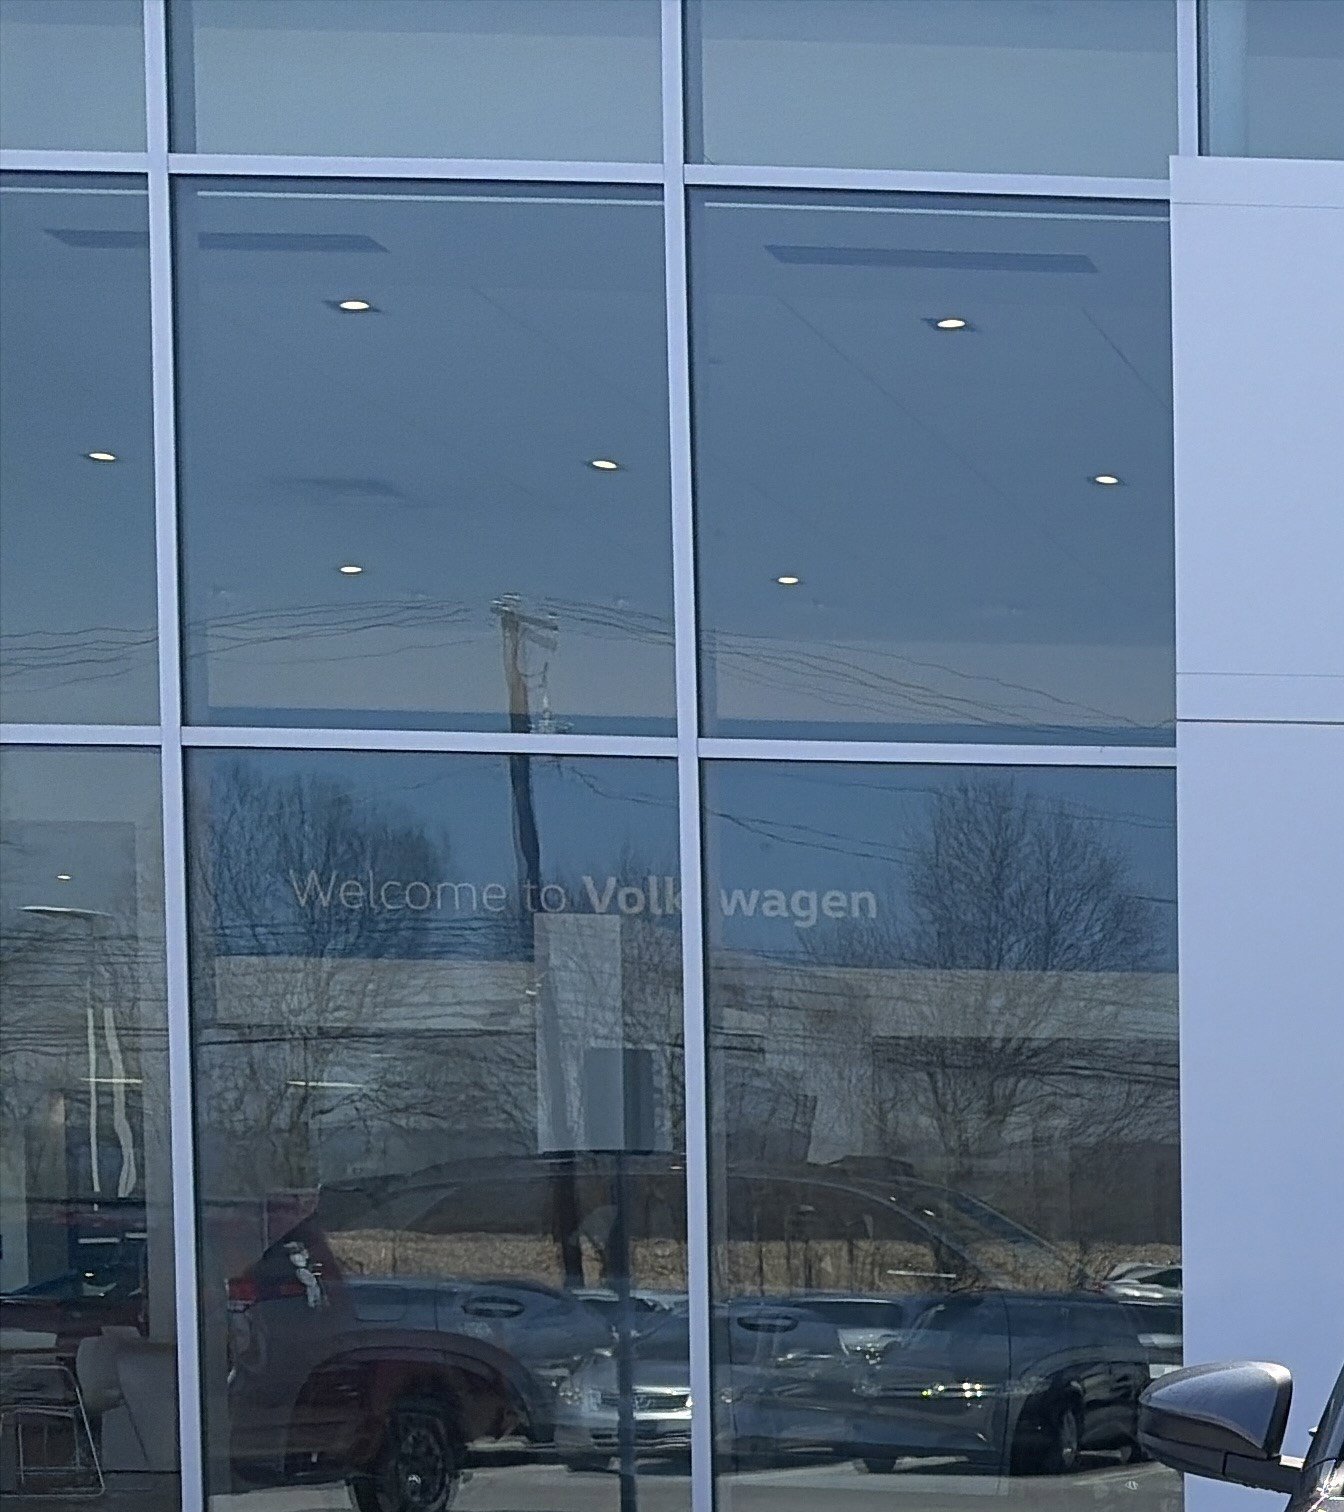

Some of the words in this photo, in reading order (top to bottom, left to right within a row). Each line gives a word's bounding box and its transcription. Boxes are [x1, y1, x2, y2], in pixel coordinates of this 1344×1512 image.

[289, 868, 507, 914] Welcome
[521, 876, 567, 914] to
[582, 875, 878, 928] Volkwagen
